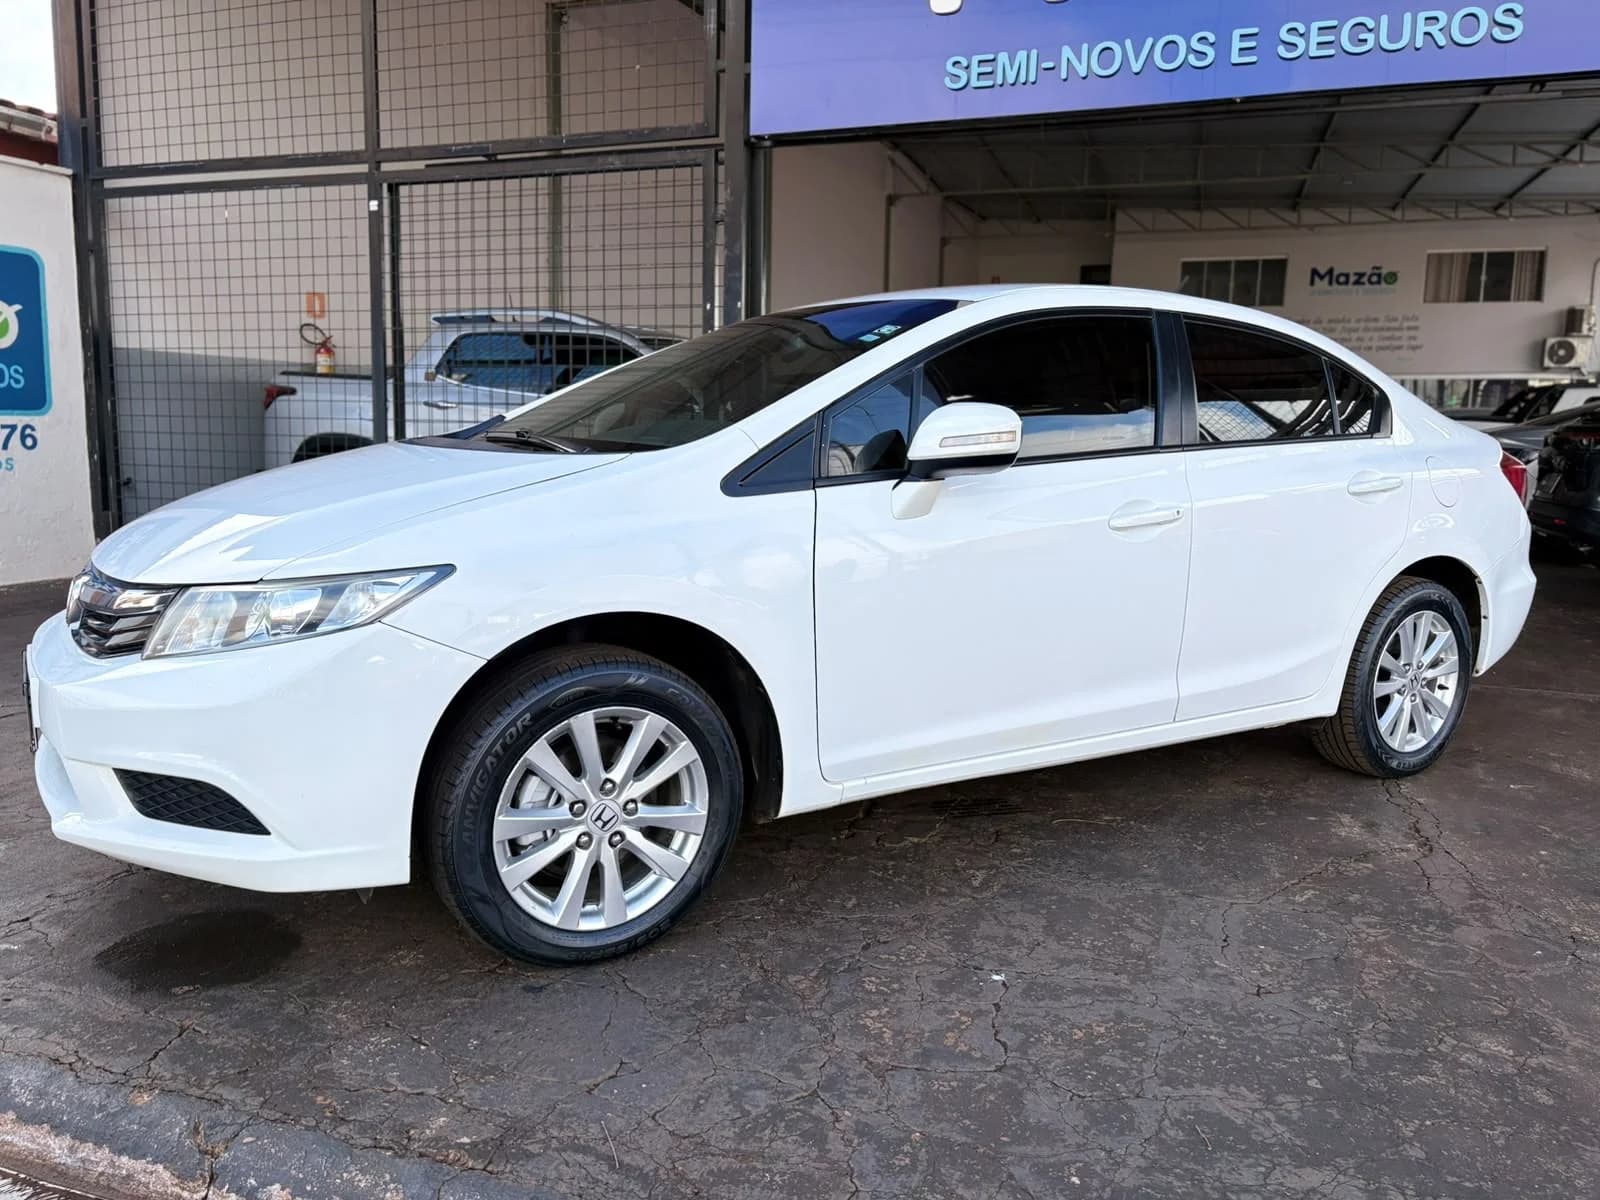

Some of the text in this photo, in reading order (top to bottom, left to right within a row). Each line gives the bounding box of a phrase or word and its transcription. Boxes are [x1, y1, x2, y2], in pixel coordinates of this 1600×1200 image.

[944, 3, 1525, 91] SEMI-NOVOS E SEGUROS
[1309, 266, 1399, 287] Mazão
